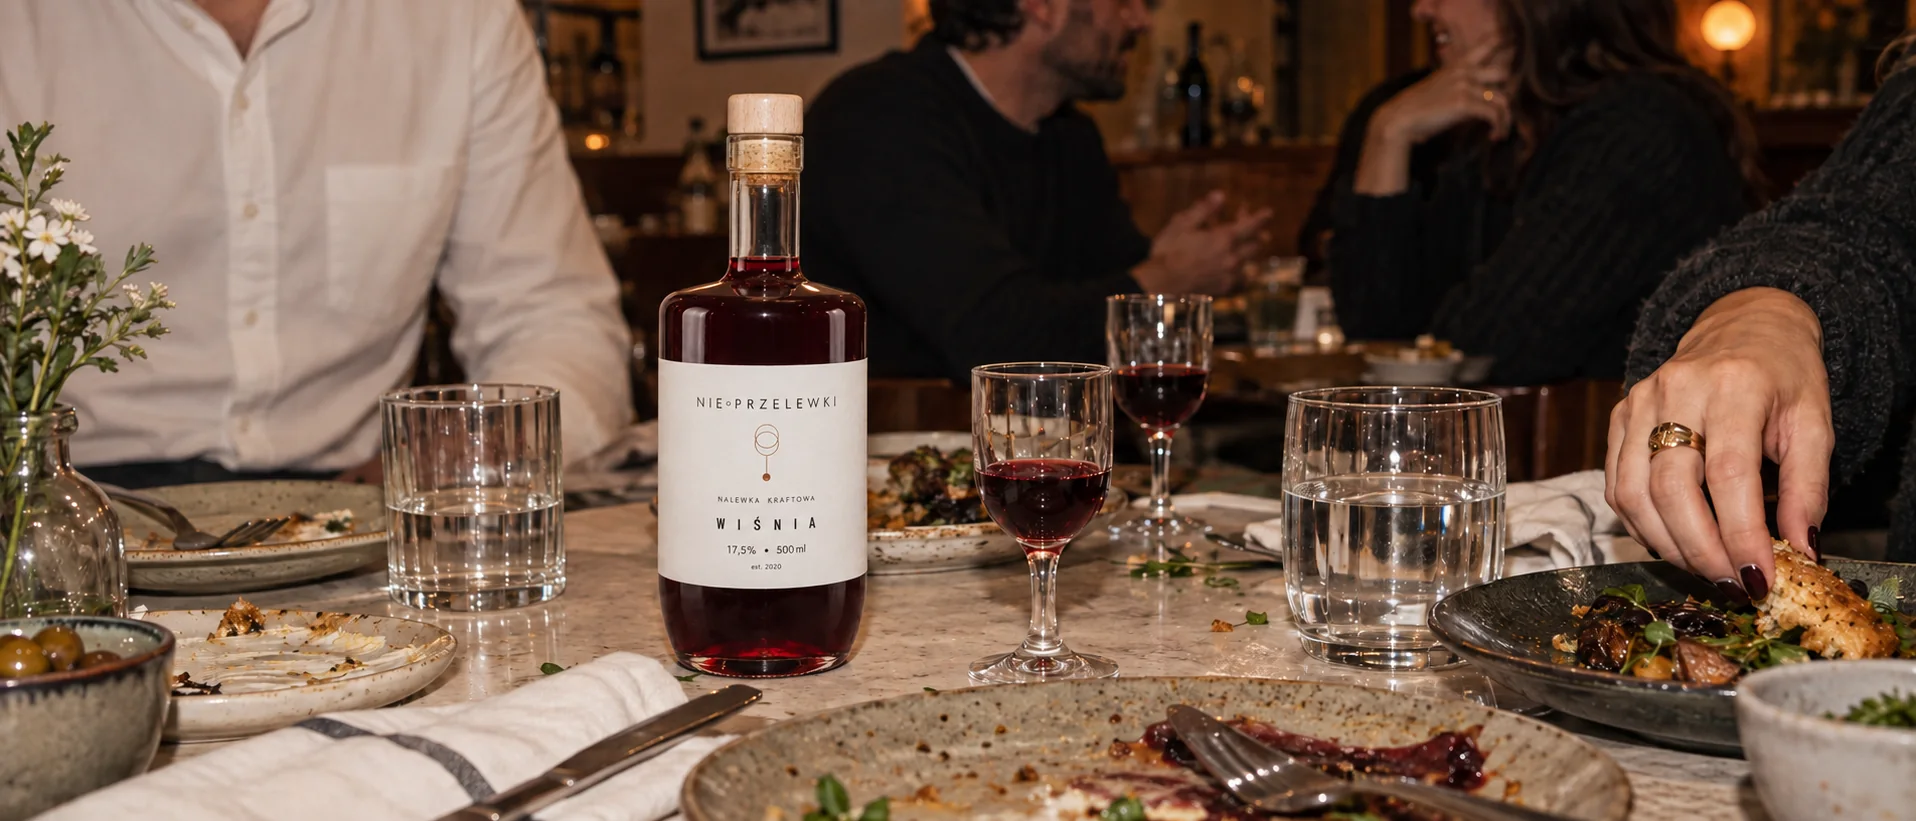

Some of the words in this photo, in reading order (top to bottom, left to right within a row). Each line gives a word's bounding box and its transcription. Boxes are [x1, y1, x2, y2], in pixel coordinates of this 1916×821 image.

[717, 496, 760, 504] NALEWKA
[767, 495, 815, 504] KRAFTOWA
[716, 516, 816, 531] WIŚNIA
[727, 545, 757, 556] 17,5%
